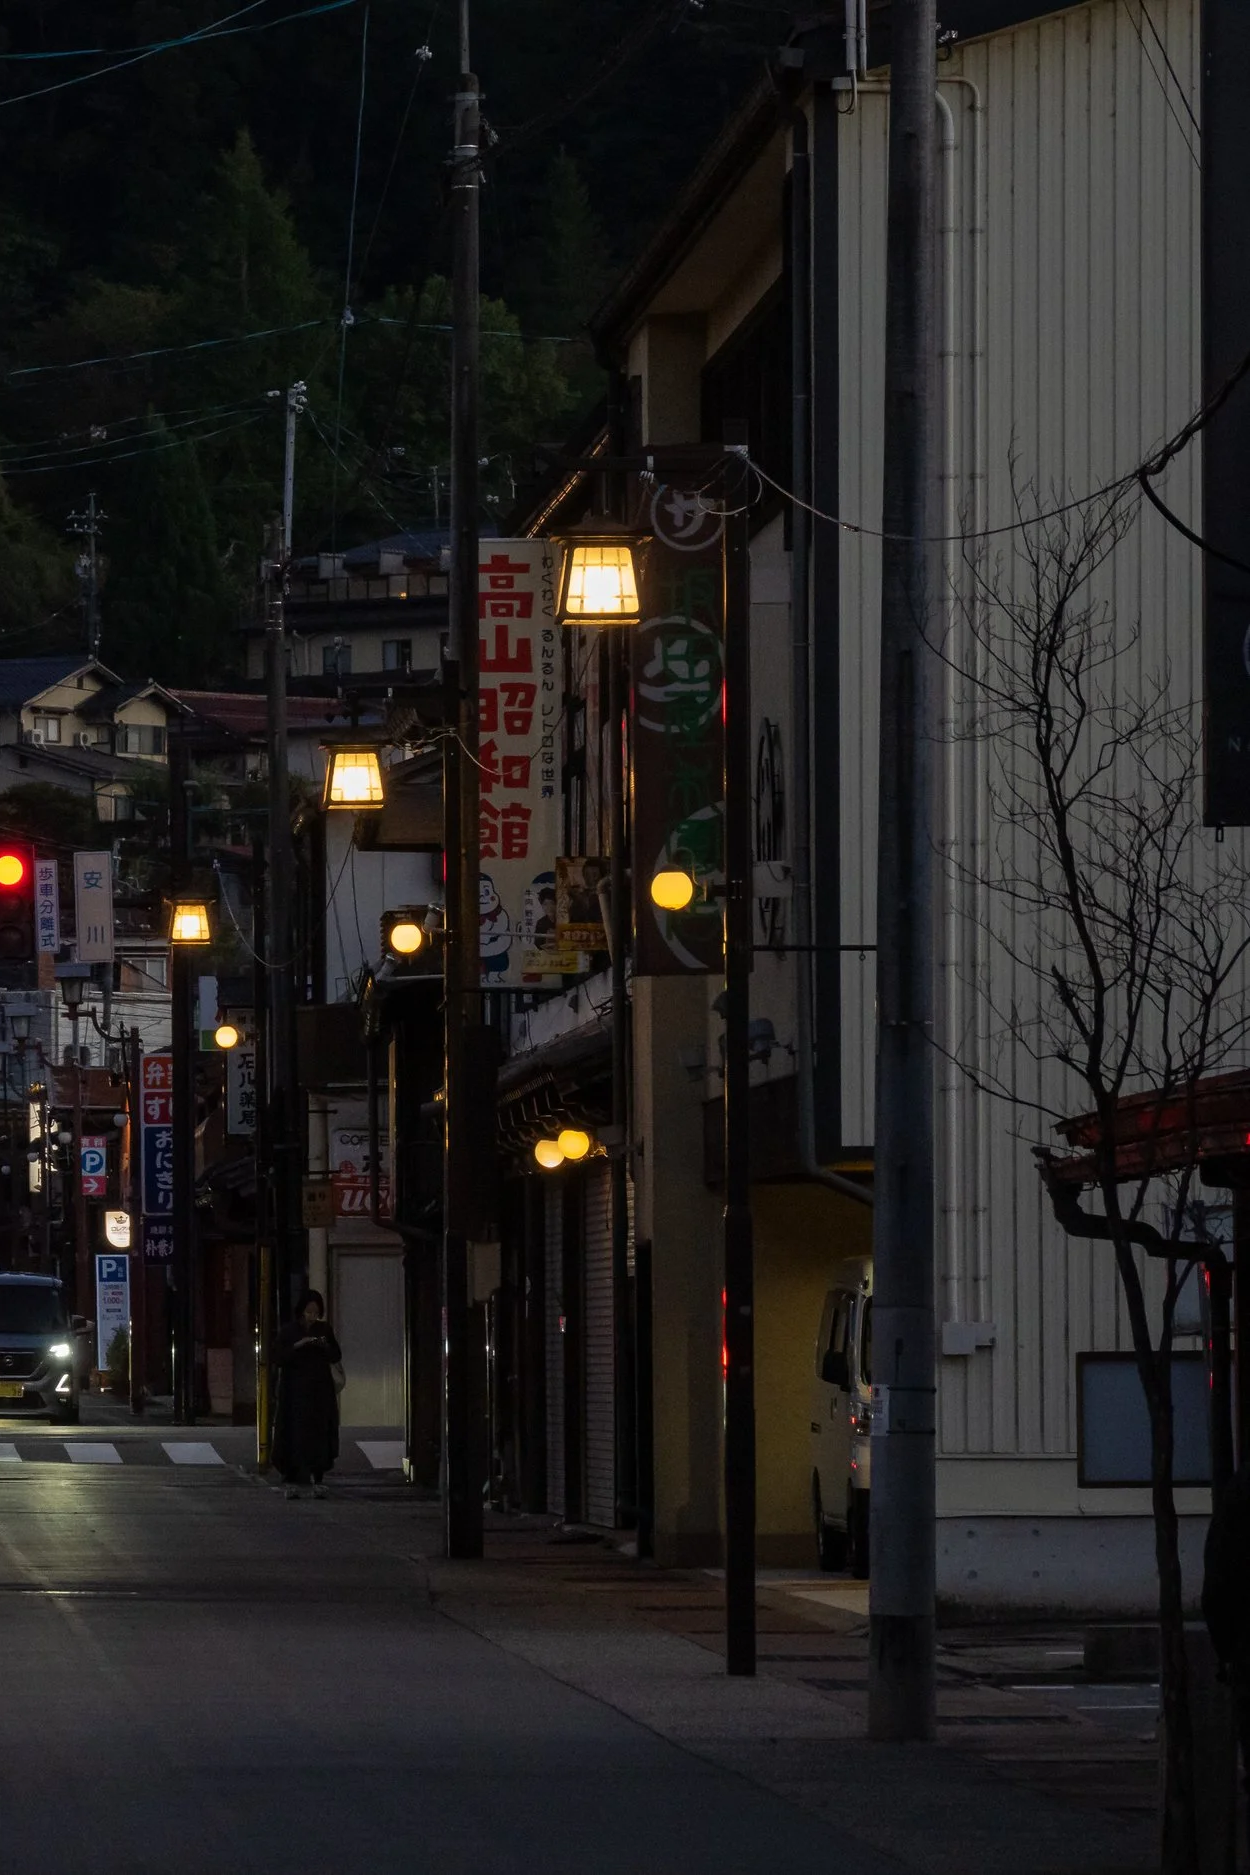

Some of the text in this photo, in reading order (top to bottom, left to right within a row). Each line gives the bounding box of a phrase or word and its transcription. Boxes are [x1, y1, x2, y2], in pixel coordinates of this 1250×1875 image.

[478, 554, 535, 860] 高山昭和館
[38, 867, 55, 947] 歩車分離式
[83, 870, 103, 944] 安川
[86, 1153, 100, 1172] P
[102, 1259, 118, 1279] P
